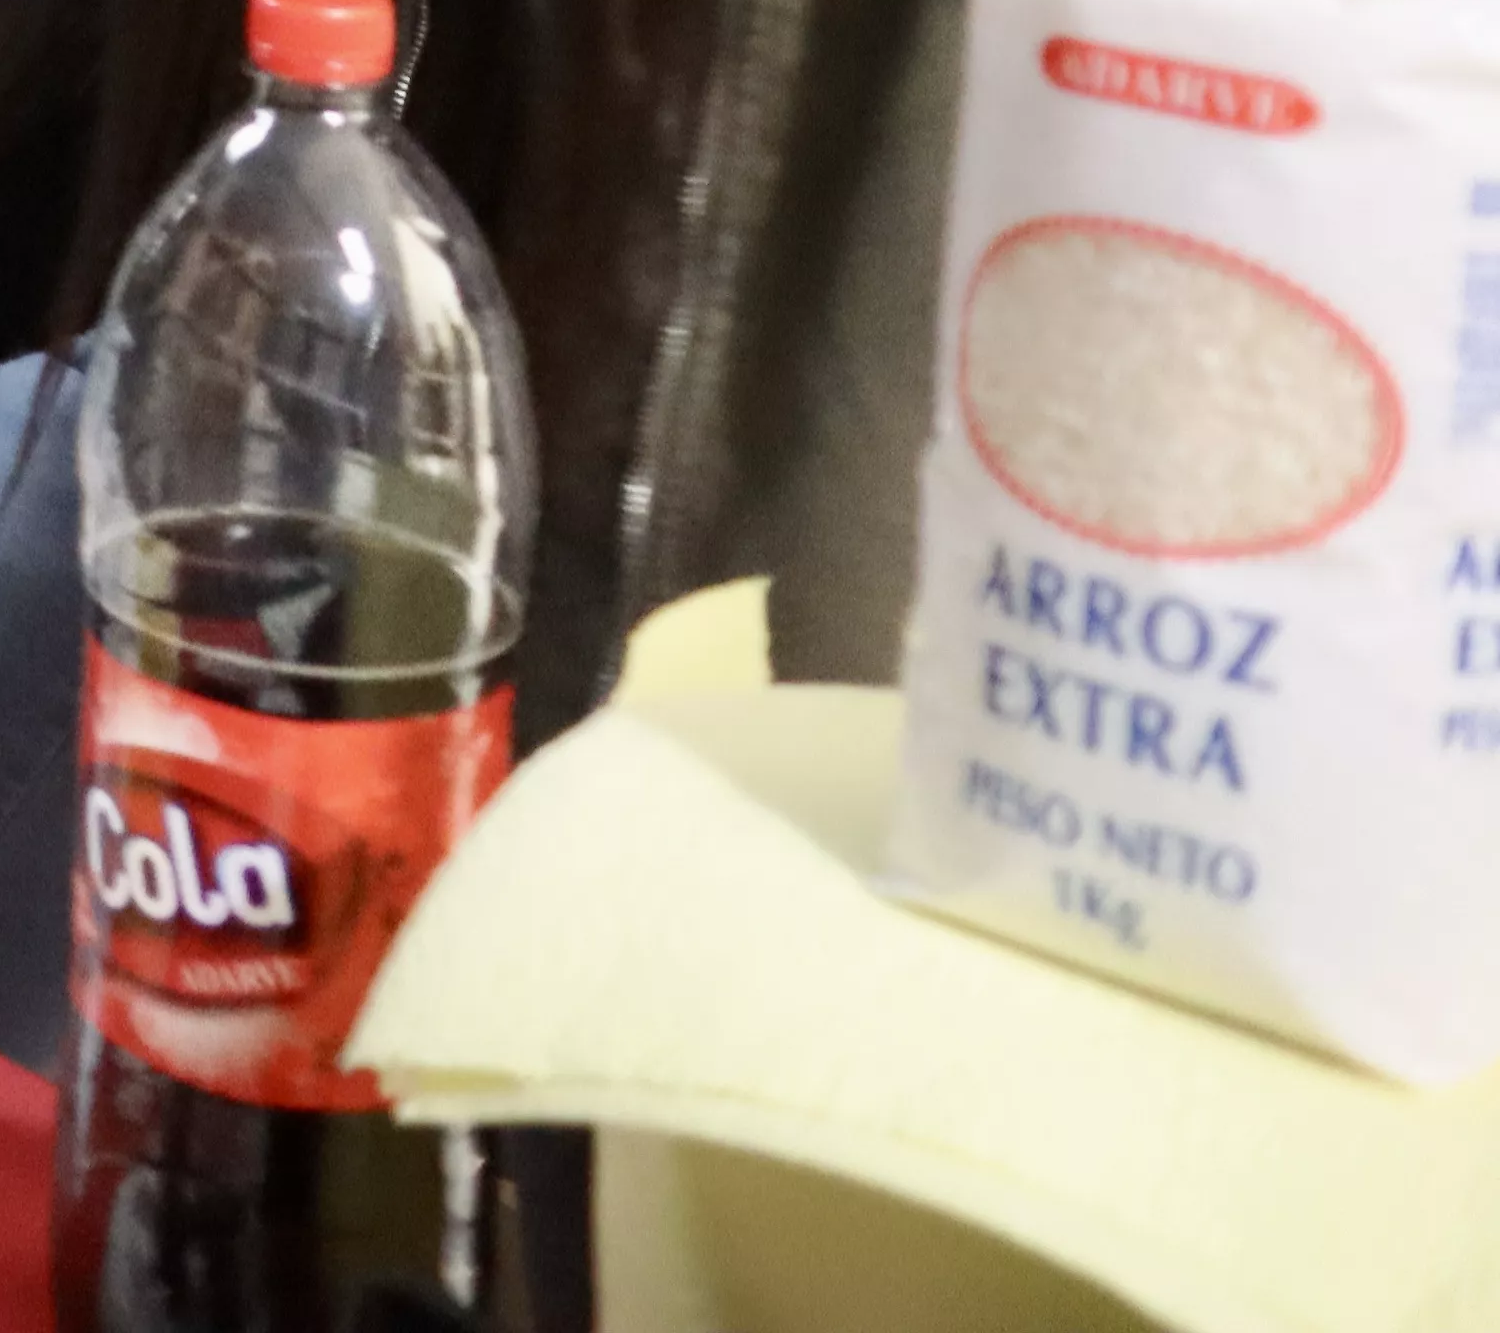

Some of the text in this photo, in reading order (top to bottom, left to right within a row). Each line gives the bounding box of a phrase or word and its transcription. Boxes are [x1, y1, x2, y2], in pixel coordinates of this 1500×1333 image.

[980, 540, 1283, 691] ARROZ
[985, 640, 1246, 792] EXTRA
[85, 788, 294, 929] Cola
